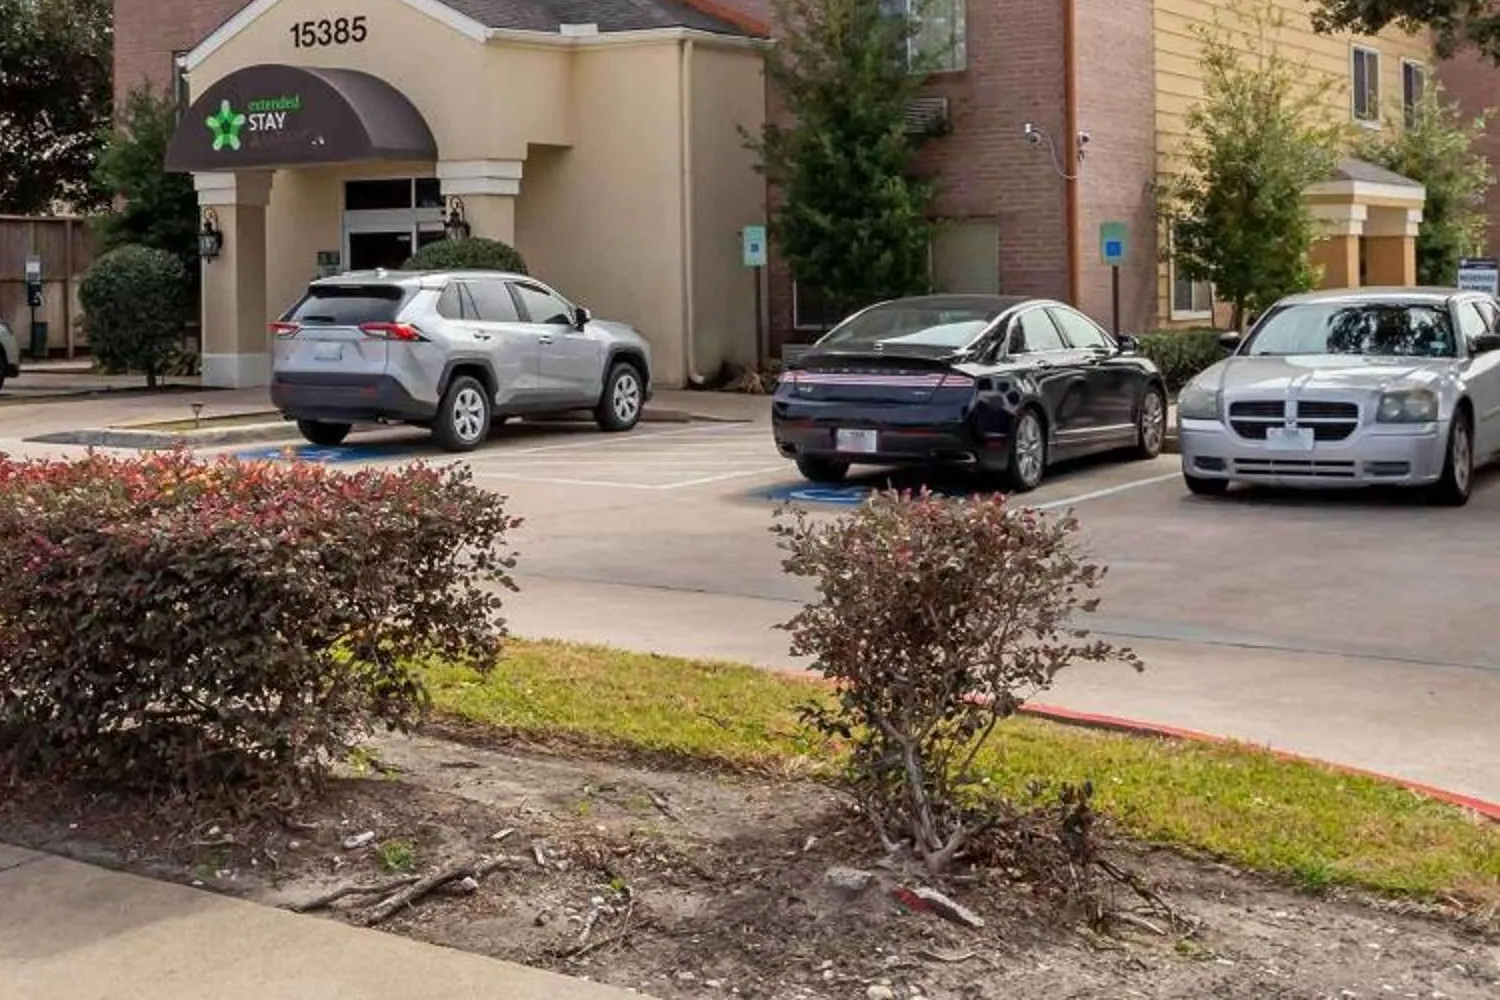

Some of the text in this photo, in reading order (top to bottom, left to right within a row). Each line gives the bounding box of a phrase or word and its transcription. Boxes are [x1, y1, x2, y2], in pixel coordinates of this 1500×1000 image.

[289, 15, 367, 48] 15385
[248, 95, 300, 112] extended
[248, 112, 287, 131] STAY
